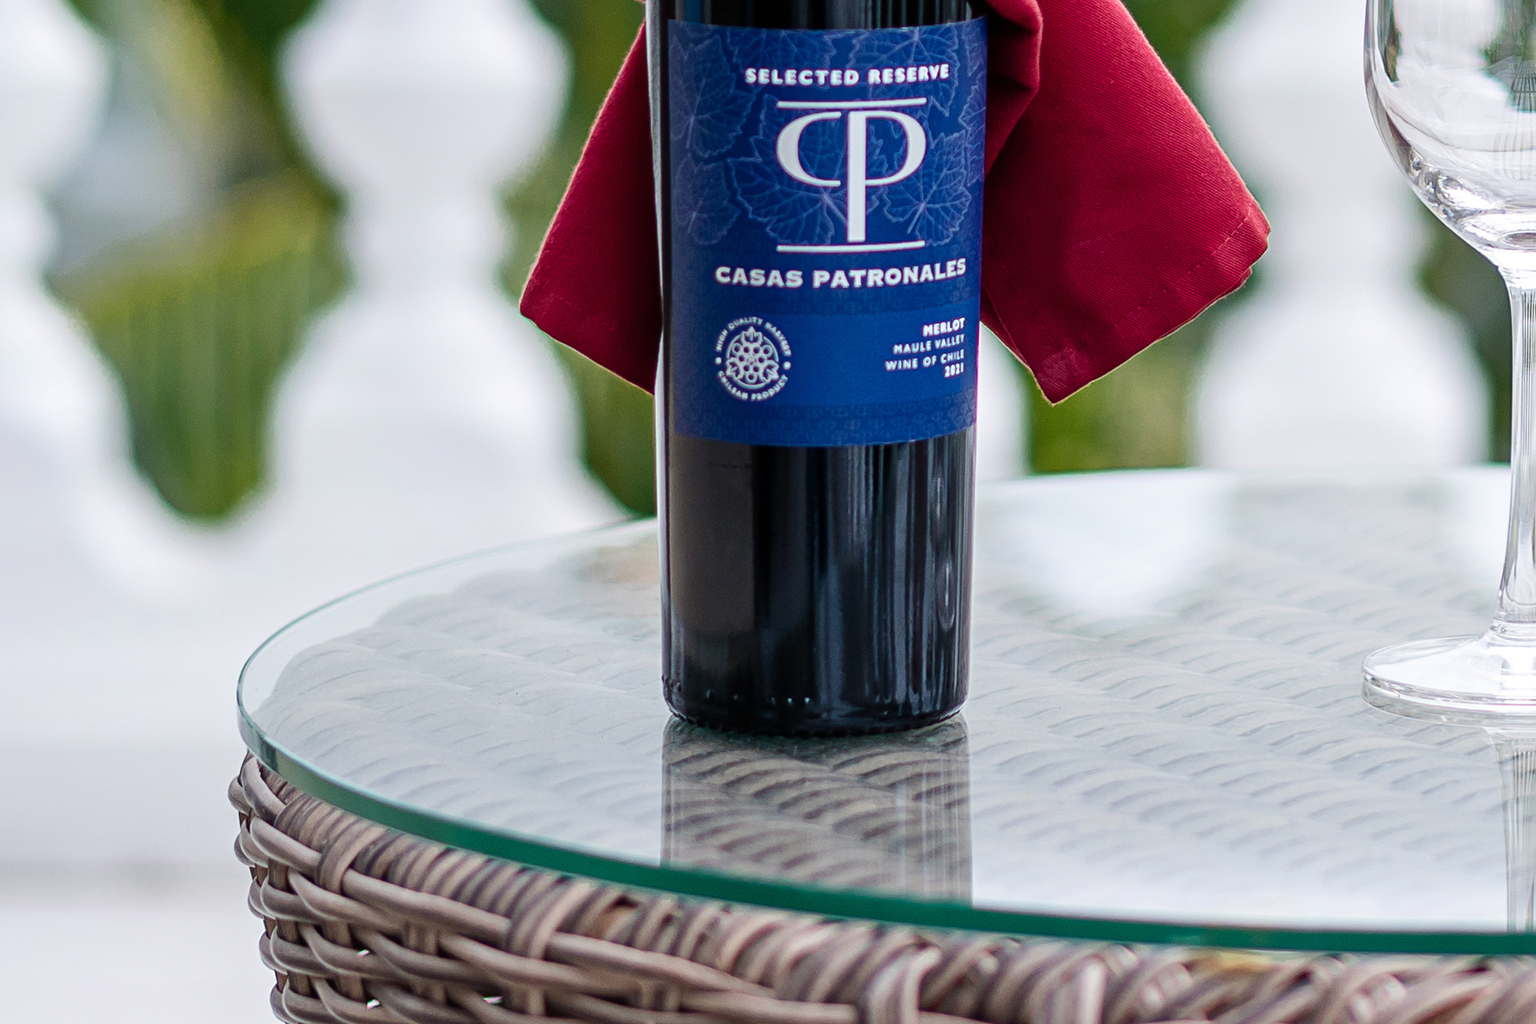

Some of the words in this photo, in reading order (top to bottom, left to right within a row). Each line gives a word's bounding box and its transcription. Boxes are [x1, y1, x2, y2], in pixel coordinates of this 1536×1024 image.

[745, 67, 860, 86] SELECTED
[868, 63, 950, 85] RESERVE
[714, 265, 804, 289] CASAS
[812, 257, 967, 289] PATRONALES
[715, 328, 729, 353] HIGH
[727, 316, 764, 331] QUALITY
[922, 317, 966, 337] MERLOT
[893, 340, 932, 355] MAULE
[934, 333, 965, 350] VALLEY
[884, 357, 919, 372] WINE
[922, 355, 938, 368] OF
[940, 348, 965, 365] CHILE
[943, 361, 965, 378] 2021
[717, 370, 749, 401] CHILEAN
[750, 373, 789, 402] PRODUCT
